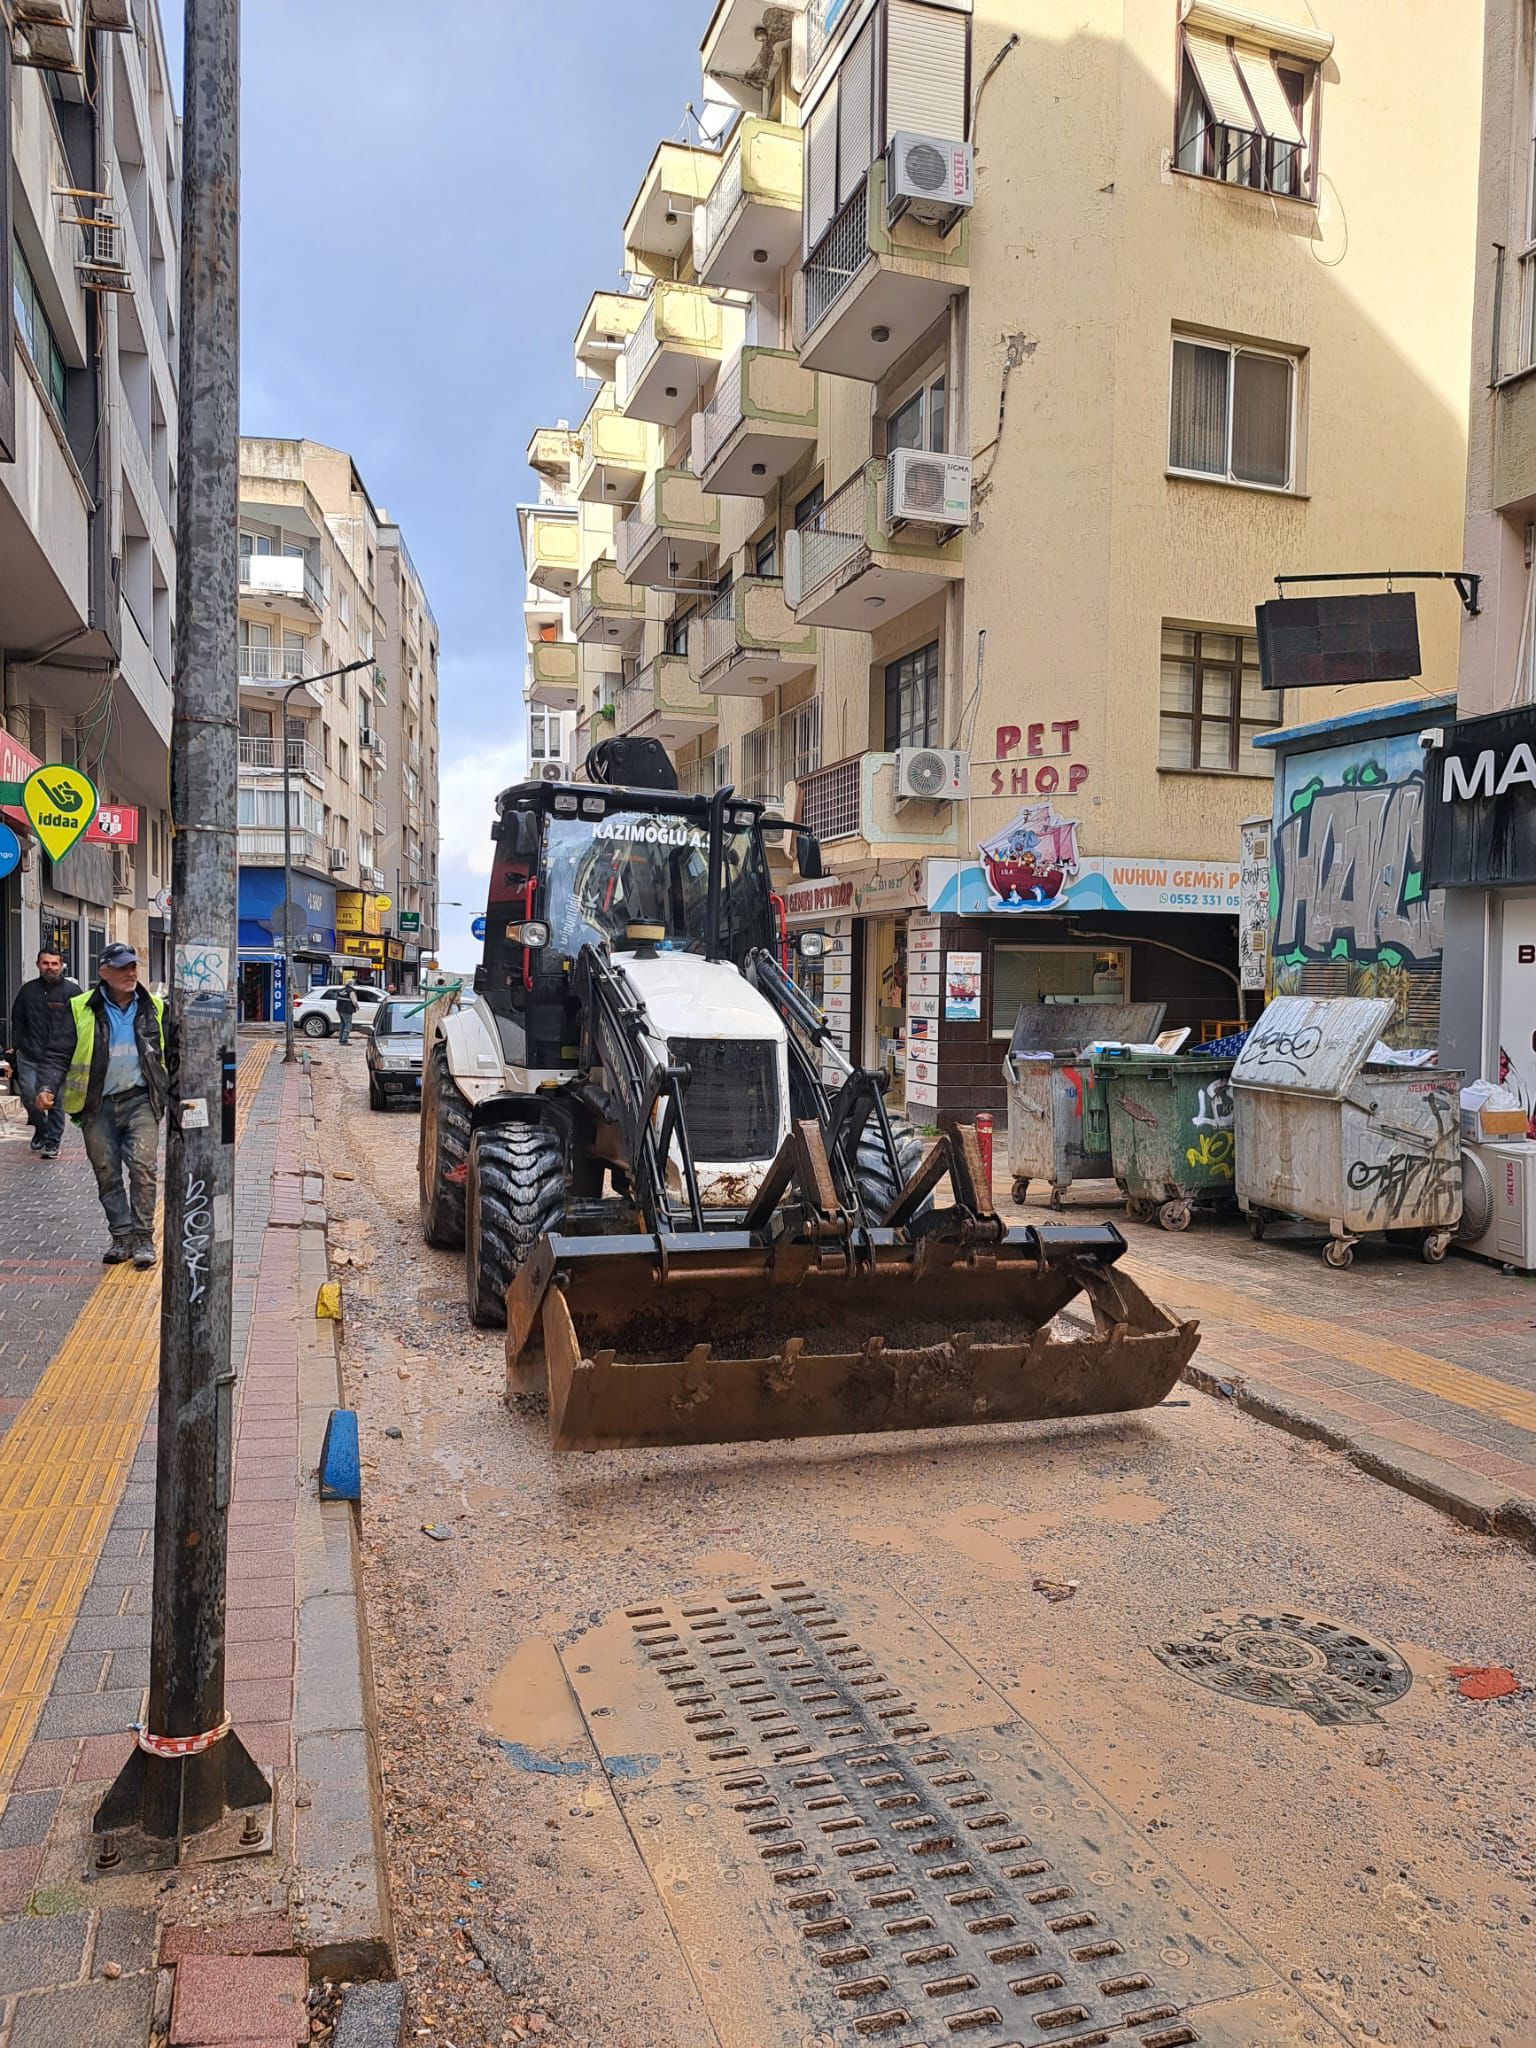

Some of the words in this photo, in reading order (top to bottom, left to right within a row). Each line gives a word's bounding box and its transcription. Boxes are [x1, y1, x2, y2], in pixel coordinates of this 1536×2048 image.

[953, 149, 965, 196] VESTEL
[995, 720, 1080, 760] PET
[990, 763, 1090, 796] SHOP
[38, 812, 78, 828] iddaa
[591, 822, 687, 846] KAZIMOĞLU
[1112, 867, 1168, 887] NUHUN
[1169, 893, 1199, 906] 0552
[1201, 895, 1222, 906] 331
[1226, 895, 1240, 907] 05
[274, 969, 282, 1010] SHOP
[1505, 1161, 1514, 1197] ALTUS
